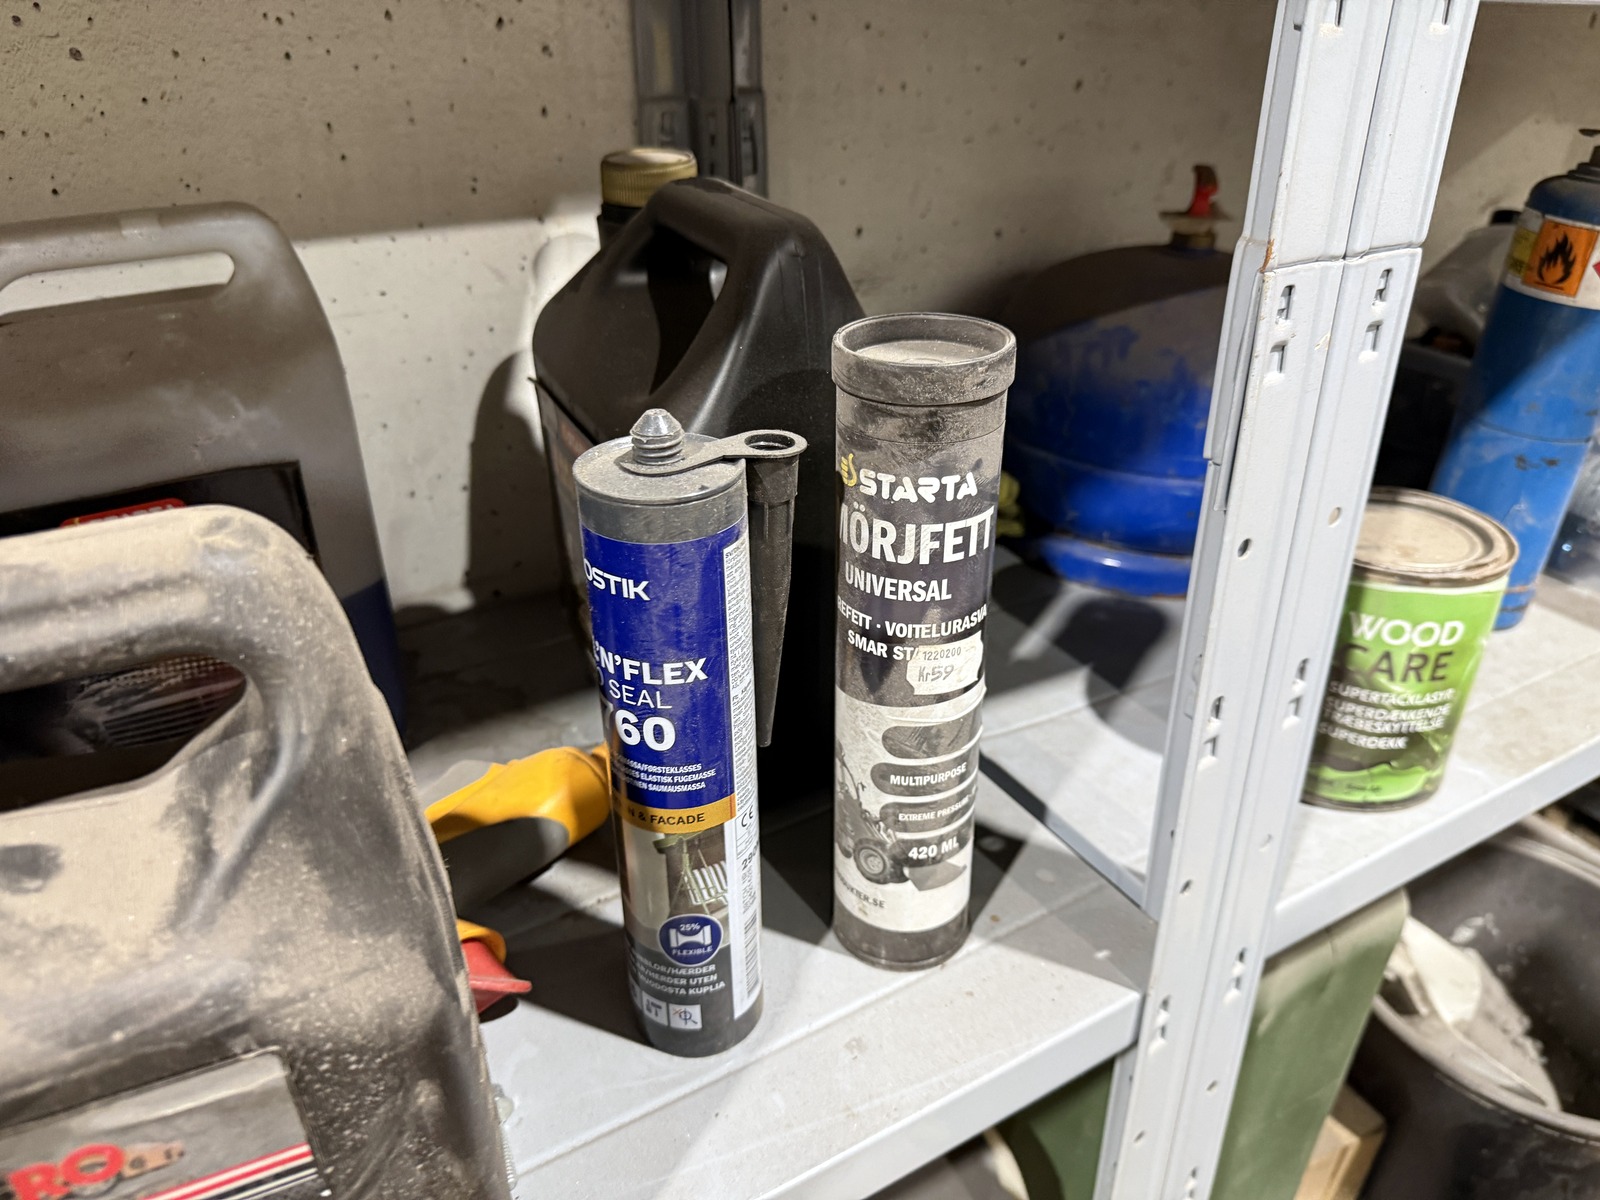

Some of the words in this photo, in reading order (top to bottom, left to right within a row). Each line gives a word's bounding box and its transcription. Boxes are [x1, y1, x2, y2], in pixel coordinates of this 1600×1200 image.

[859, 468, 978, 503] STARTA
[845, 561, 952, 603] UNIVERSAL
[1350, 611, 1465, 648] WOOD
[848, 629, 888, 658] SMAR
[922, 646, 962, 662] 1220200
[1338, 643, 1454, 683] CARE
[608, 678, 673, 709] SEAL
[889, 761, 968, 786] MULTIPURPOSE
[650, 812, 706, 825] FACADE
[898, 811, 936, 821] EXTREME
[908, 844, 938, 860] 420
[941, 836, 959, 854] ML
[680, 922, 701, 932] 25%
[672, 945, 713, 956] FLEXIBLE
[689, 973, 718, 985] UTEN
